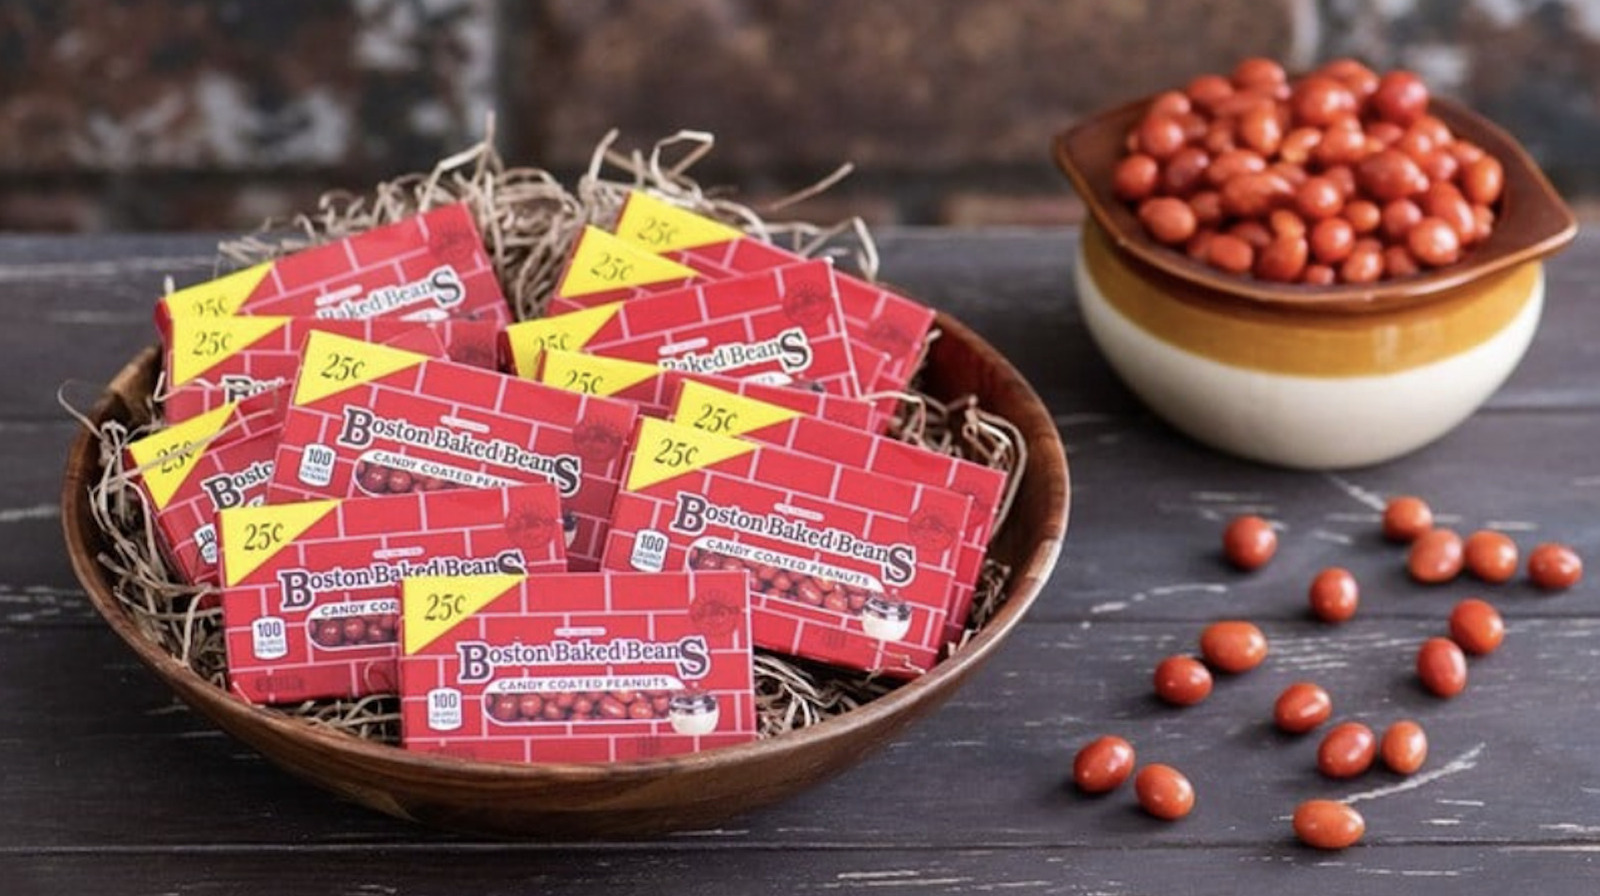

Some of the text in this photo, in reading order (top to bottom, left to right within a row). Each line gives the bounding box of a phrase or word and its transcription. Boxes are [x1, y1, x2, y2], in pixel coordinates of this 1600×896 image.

[340, 408, 429, 446] Boston
[435, 429, 499, 460] Baked
[308, 448, 333, 466] 100
[373, 452, 417, 469] CANDY
[420, 463, 473, 483] COATED
[204, 463, 274, 510] Bosto
[671, 493, 763, 532] Boston
[769, 517, 833, 548] Baked
[640, 534, 665, 553] 100
[705, 539, 869, 586] CANDY COATED PEANUTS
[280, 570, 370, 608] Boston
[374, 560, 440, 584] Baked
[320, 604, 366, 616] CANDY
[257, 621, 282, 637] 100
[459, 643, 549, 680] Boston
[555, 641, 621, 661] Baked
[498, 677, 668, 691] CANDY COATED PEANUTS
[433, 693, 458, 709] 100
